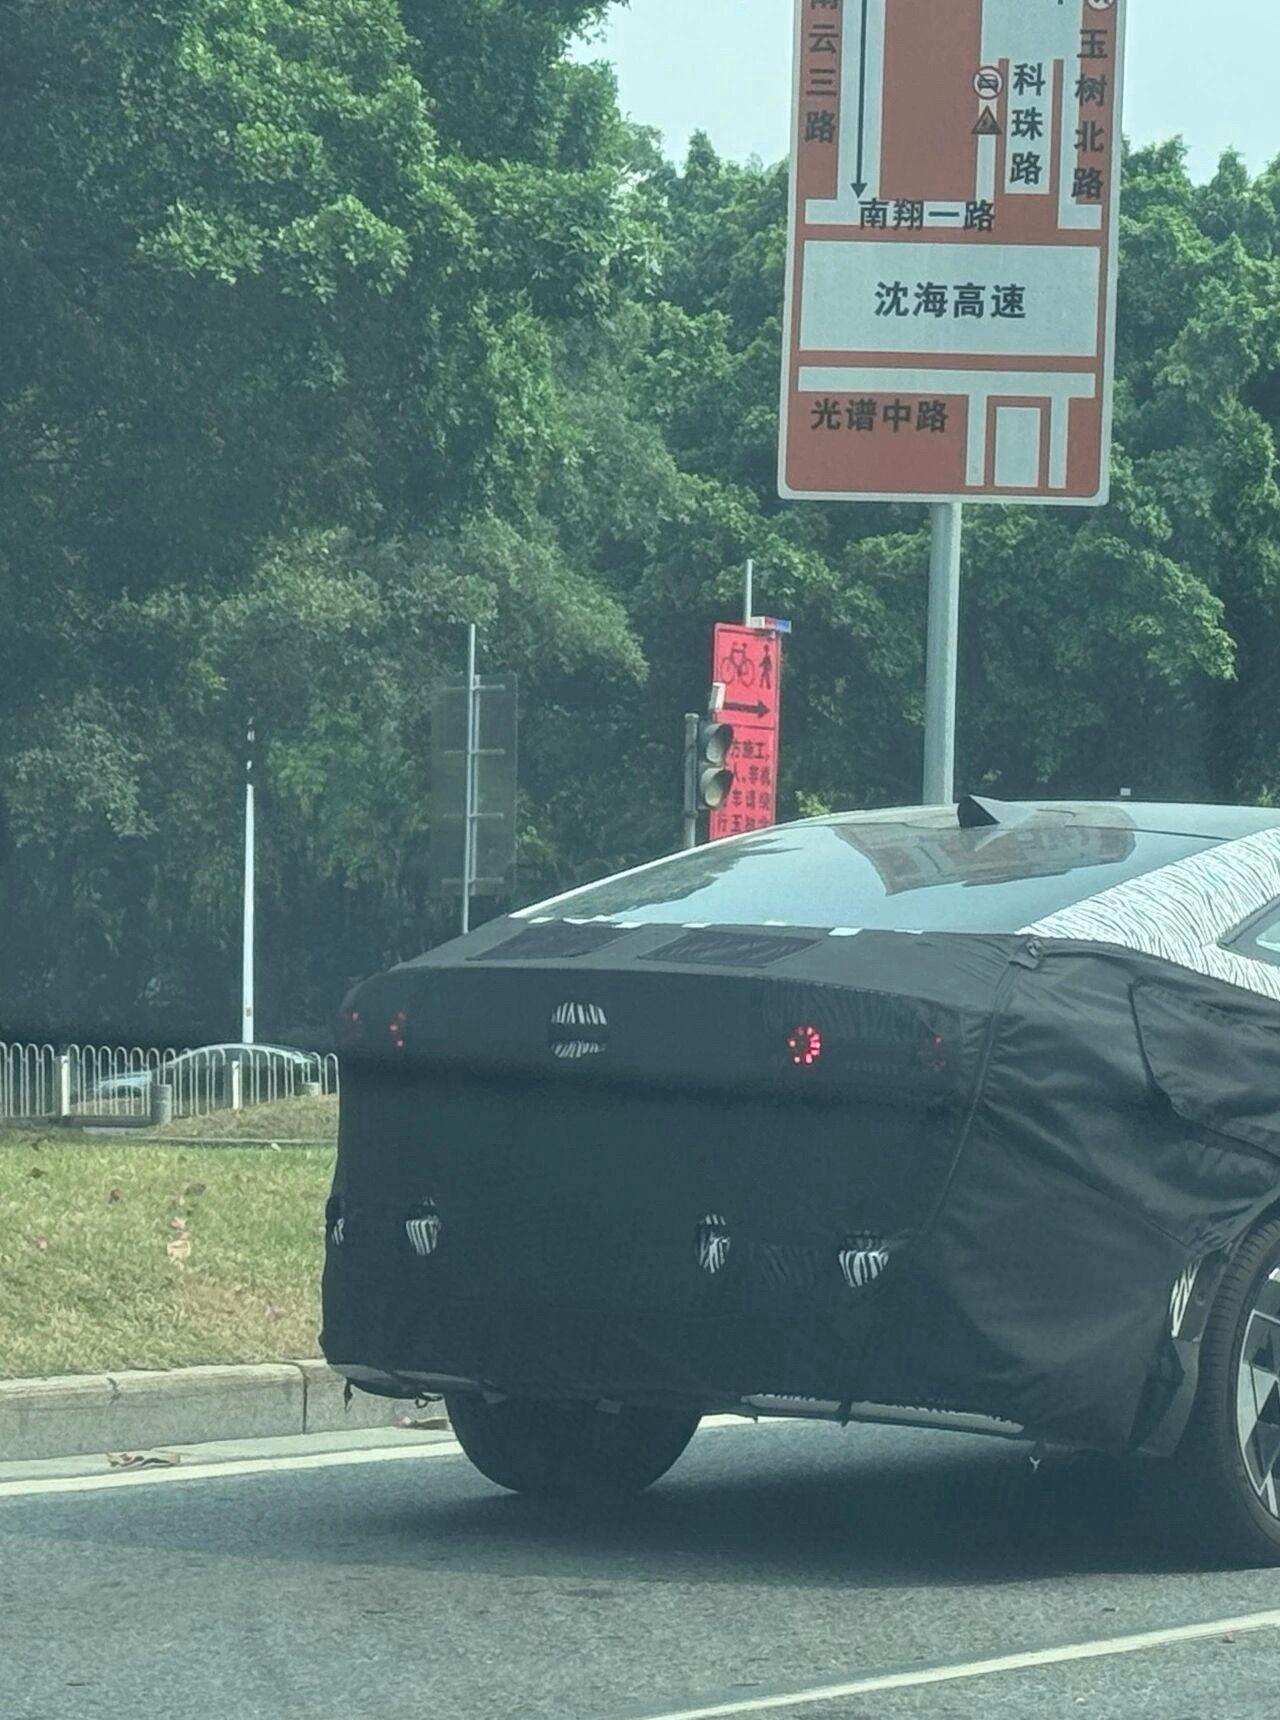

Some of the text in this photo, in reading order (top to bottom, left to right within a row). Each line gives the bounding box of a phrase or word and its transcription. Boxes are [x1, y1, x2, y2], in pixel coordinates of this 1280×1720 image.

[1010, 63, 1046, 186] 科珠路
[1071, 29, 1108, 200] 玉树北路
[859, 198, 997, 233] 南翔一路
[874, 281, 1027, 319] 沈海高速
[811, 399, 949, 433] 光谱中路
